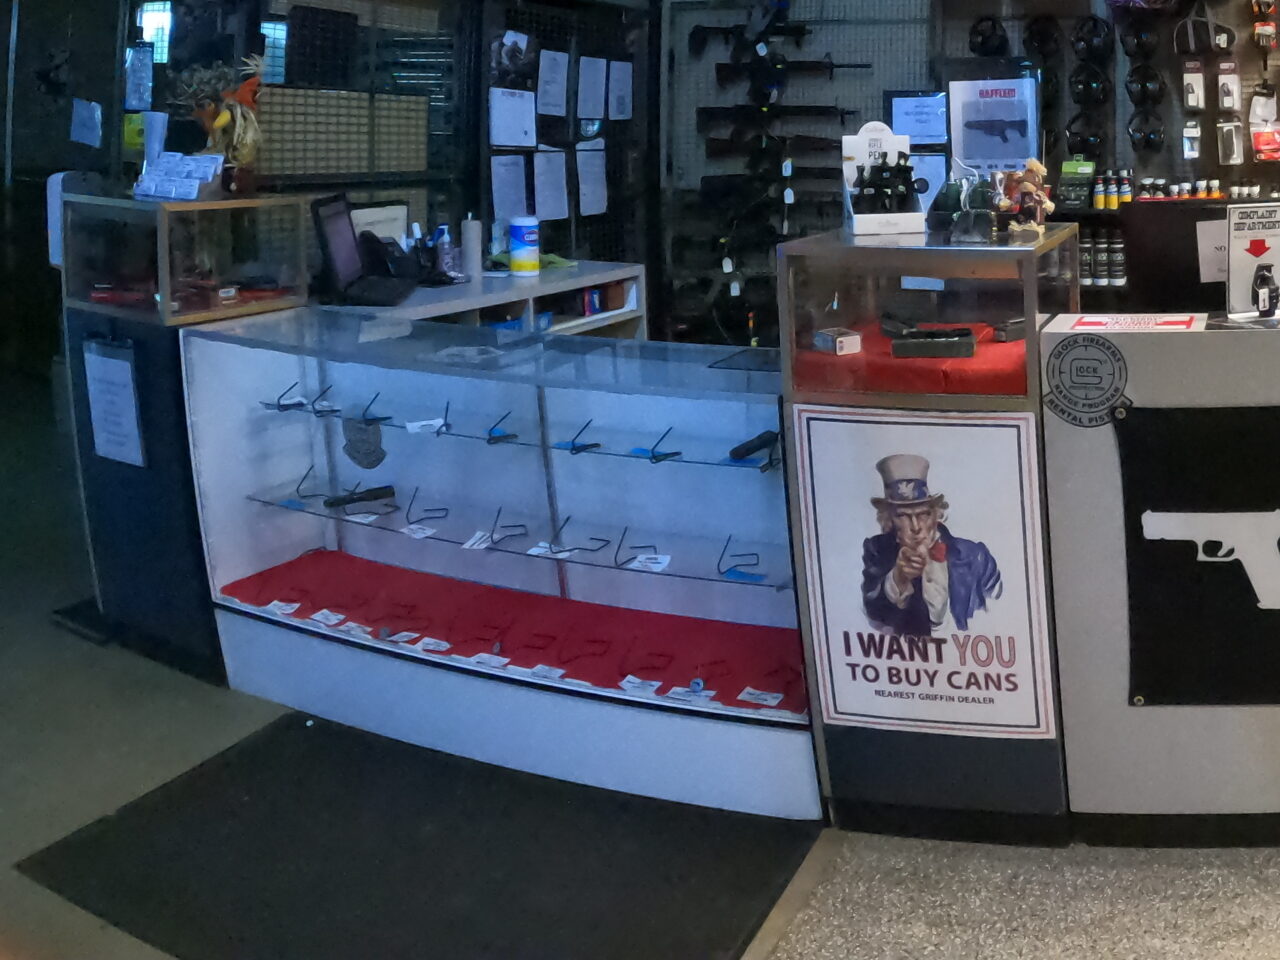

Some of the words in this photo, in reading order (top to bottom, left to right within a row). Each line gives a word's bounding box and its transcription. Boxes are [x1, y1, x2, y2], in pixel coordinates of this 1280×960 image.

[1238, 209, 1278, 220] COMPLAINT
[1053, 337, 1080, 360] GLOCK
[1082, 336, 1122, 364] FIREARMS
[1053, 383, 1080, 408] RANGE
[1081, 385, 1121, 409] PROGRAM
[1046, 398, 1084, 425] RENTAL
[842, 630, 852, 657] I
[856, 632, 948, 664] WANT
[951, 633, 1017, 669] YOU
[845, 662, 880, 684] TO
[887, 666, 939, 688] BUY
[946, 670, 1019, 692] CANS
[874, 689, 916, 700] NEAREST
[918, 692, 956, 703] GRIFFIN
[957, 695, 995, 705] DEALER
